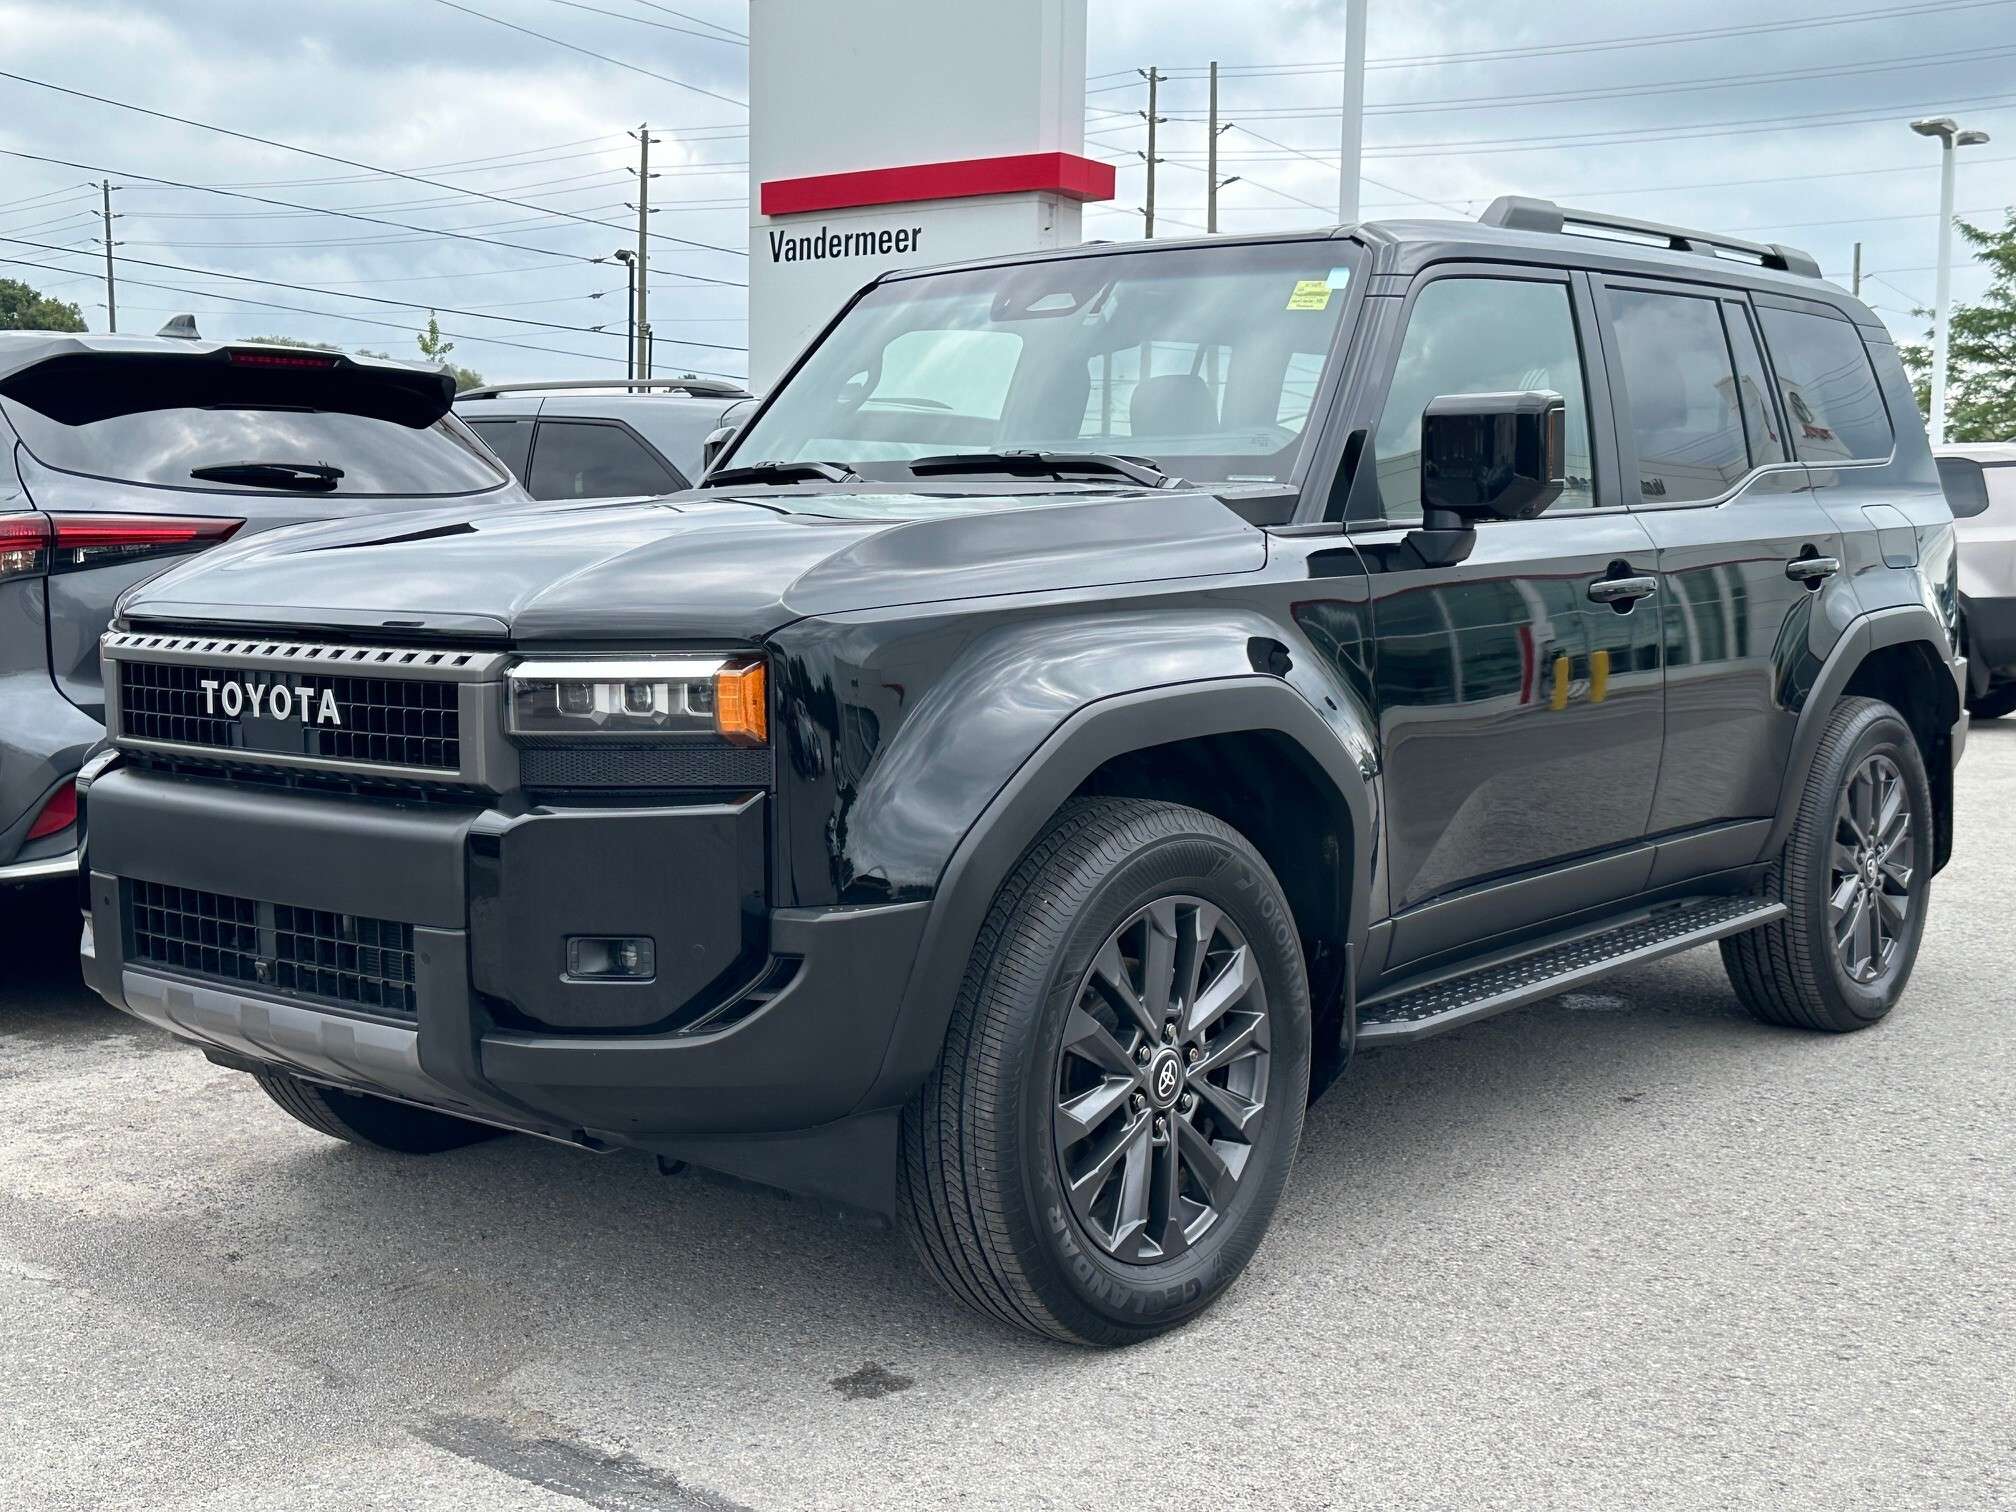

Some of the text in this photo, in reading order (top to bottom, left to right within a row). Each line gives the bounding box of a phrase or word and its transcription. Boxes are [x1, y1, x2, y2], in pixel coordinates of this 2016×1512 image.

[769, 226, 922, 263] Vandermeer
[201, 680, 341, 725] TOYOTA
[1255, 882, 1307, 1022] YOKOHAMA
